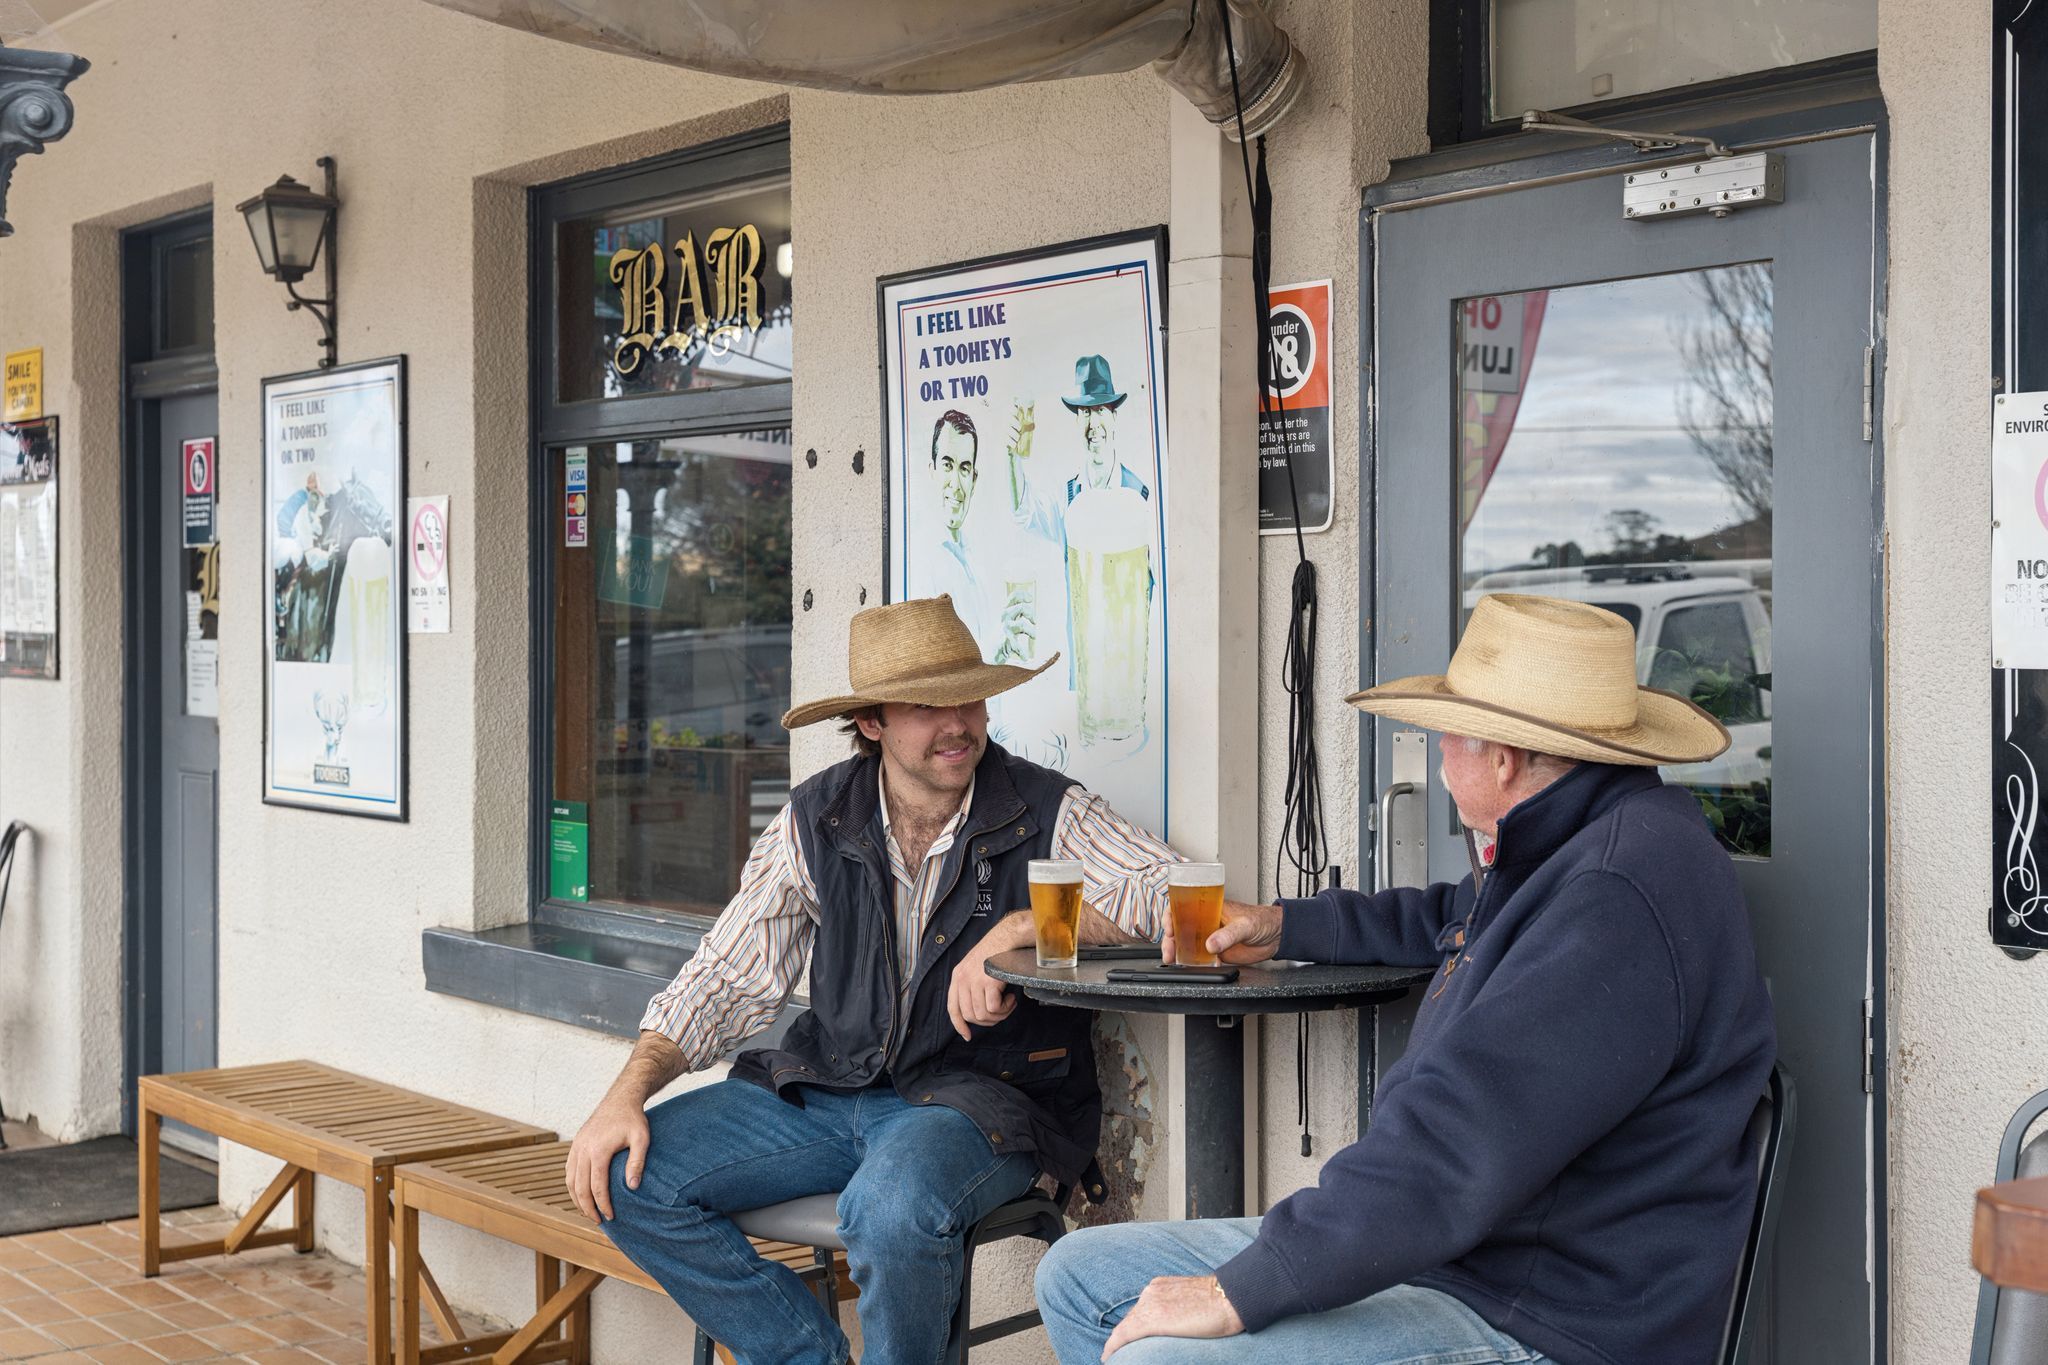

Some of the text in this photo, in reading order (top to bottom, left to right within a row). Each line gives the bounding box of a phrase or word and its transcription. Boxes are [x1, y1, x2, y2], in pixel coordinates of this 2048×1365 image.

[609, 224, 768, 378] BAR
[916, 303, 1006, 336] I FEEL LIKE
[1271, 320, 1299, 336] under
[919, 337, 1012, 369] A TOOHEYS
[1268, 335, 1298, 380] 18
[8, 361, 31, 381] SMILE
[920, 375, 989, 402] OR TWO
[280, 399, 326, 419] I FEEL LIKE
[281, 422, 328, 441] A TOOHEYS
[1296, 417, 1309, 428] the
[1260, 433, 1267, 443] of
[1298, 431, 1311, 441] are
[281, 447, 316, 464] OR TWO
[1294, 442, 1301, 453] in
[1302, 441, 1316, 453] this
[1263, 457, 1271, 470] by
[569, 469, 585, 482] VISA
